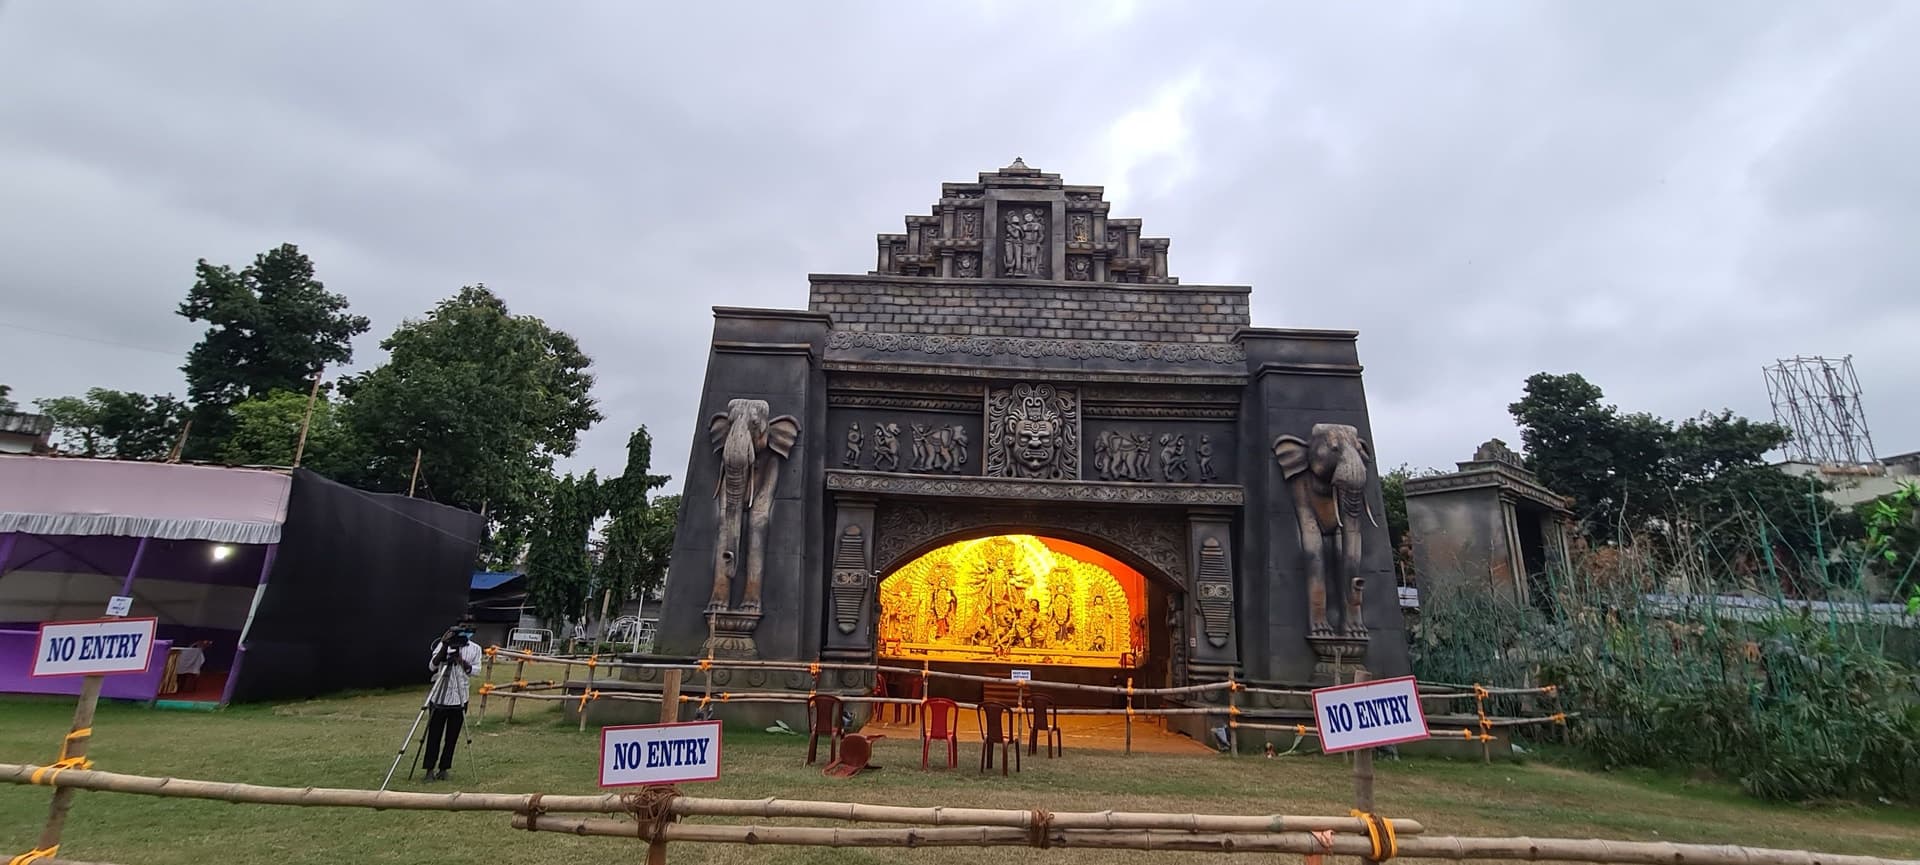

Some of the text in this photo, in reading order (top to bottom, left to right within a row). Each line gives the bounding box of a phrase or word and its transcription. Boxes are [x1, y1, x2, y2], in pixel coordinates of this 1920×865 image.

[46, 633, 143, 662] NO ENTRY
[1325, 695, 1412, 733] NO ENTRY
[613, 738, 709, 770] NO ENTRY
